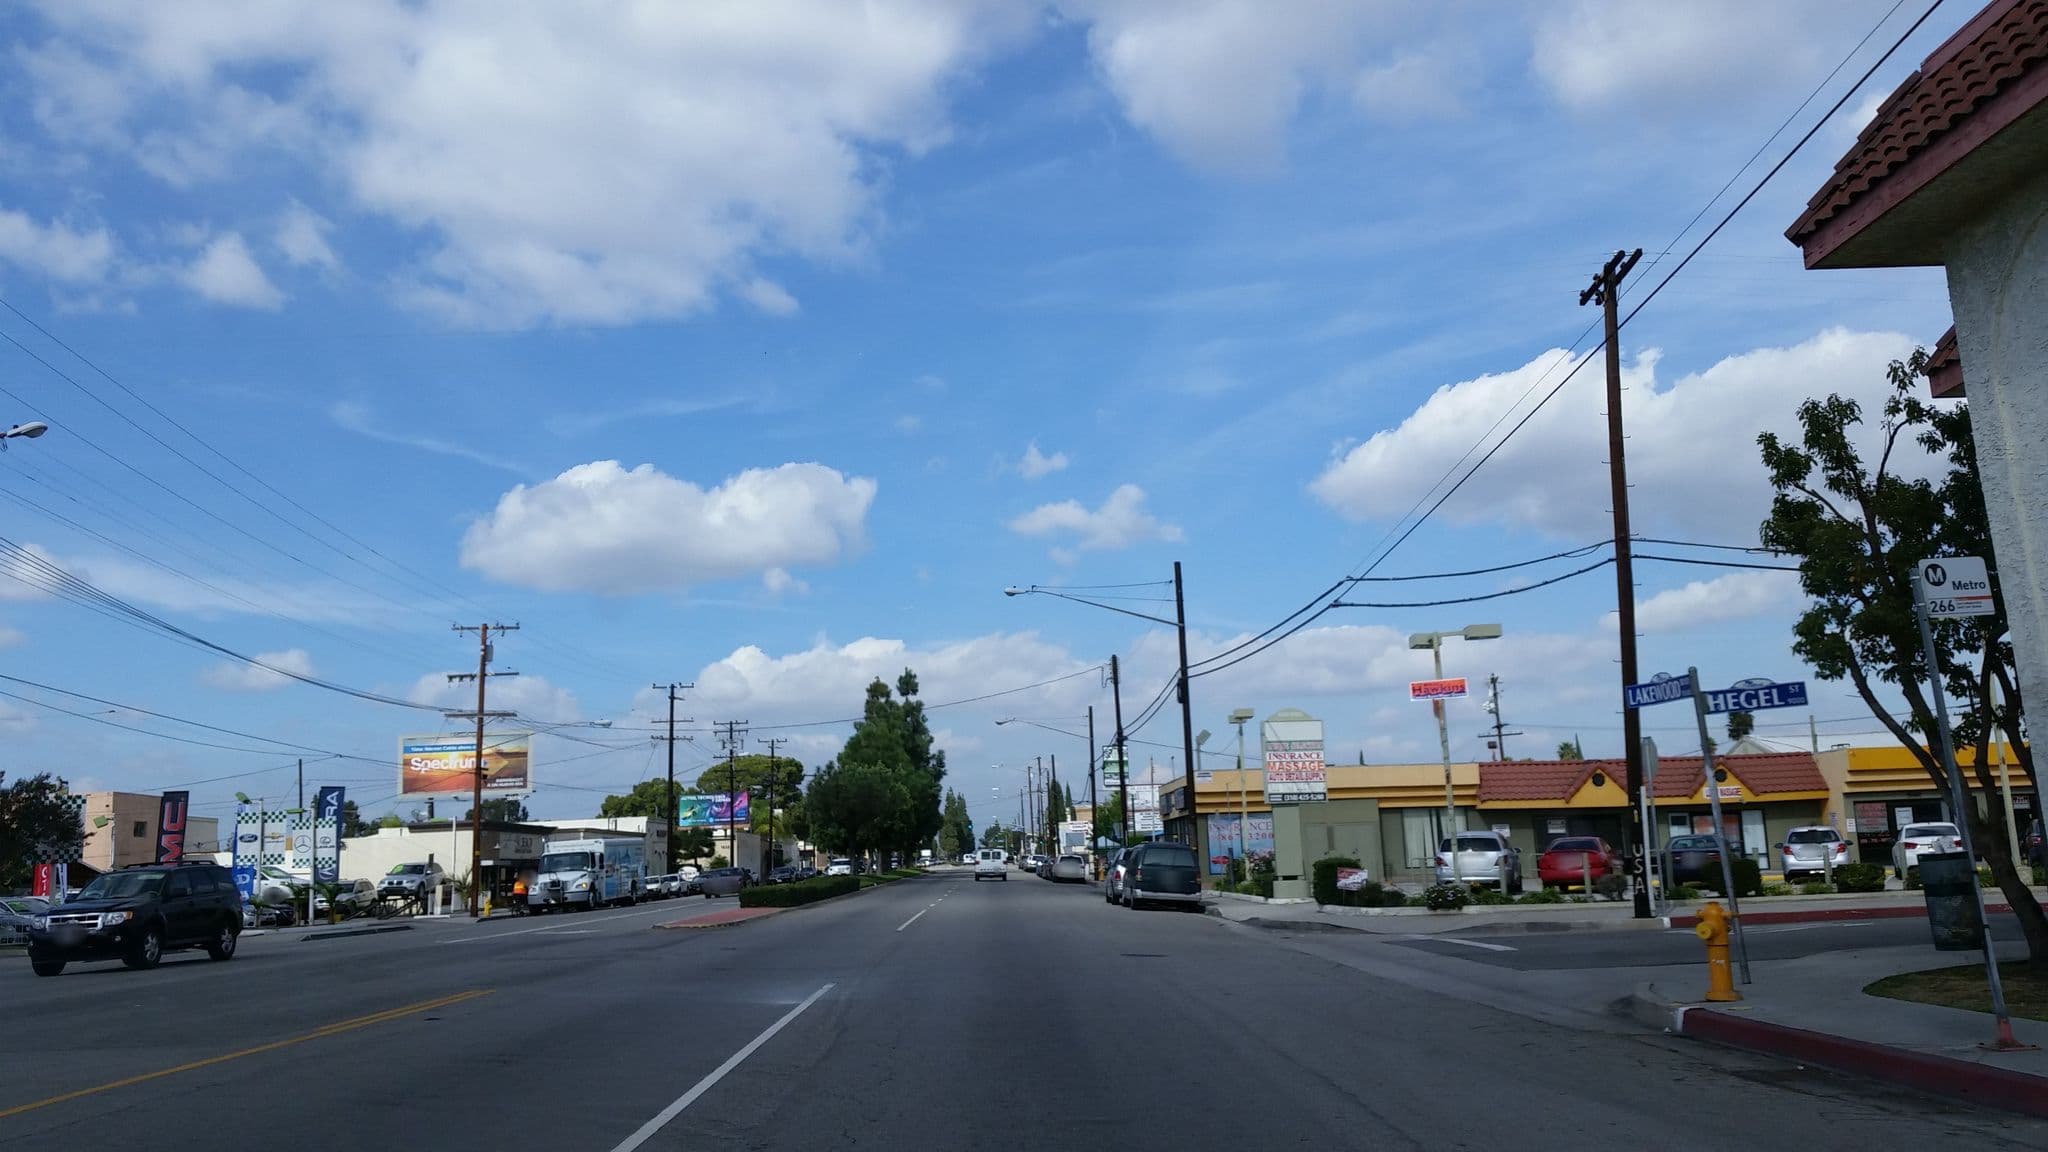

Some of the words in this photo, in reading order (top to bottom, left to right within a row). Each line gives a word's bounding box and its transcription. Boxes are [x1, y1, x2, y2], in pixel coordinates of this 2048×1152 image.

[1952, 581, 1986, 590] Metro
[1930, 600, 1956, 613] 266
[1412, 684, 1465, 695] Hawkins
[1628, 680, 1681, 705] LAKEWOOD
[1709, 688, 1785, 713] HEGEL
[1268, 752, 1322, 760] INSURANCE
[410, 757, 488, 774] Spectrum
[1267, 761, 1324, 771] MASSAGE
[160, 801, 185, 863] MC
[1209, 821, 1273, 832] INSURNCE
